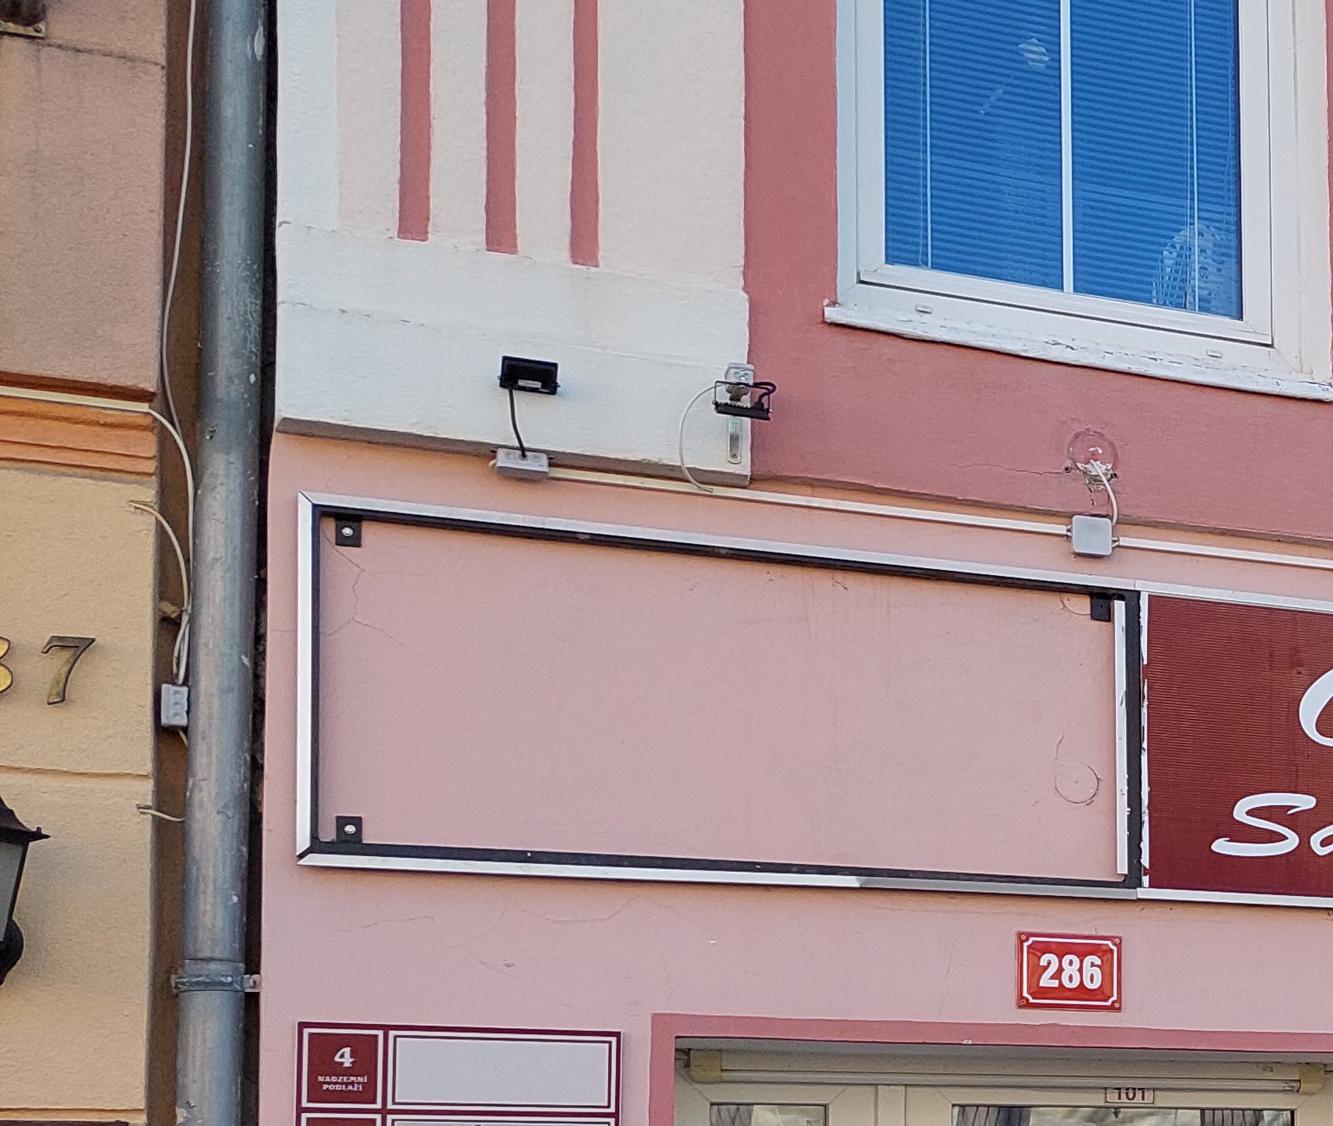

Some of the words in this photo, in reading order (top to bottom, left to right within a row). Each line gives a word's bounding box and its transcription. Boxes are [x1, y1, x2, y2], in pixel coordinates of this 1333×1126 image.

[1039, 953, 1102, 990] 286
[333, 1046, 355, 1068] 4
[317, 1074, 368, 1084] NADZEMNÍ
[322, 1083, 363, 1092] PODLAŽÍ
[1114, 1087, 1148, 1102] 101
